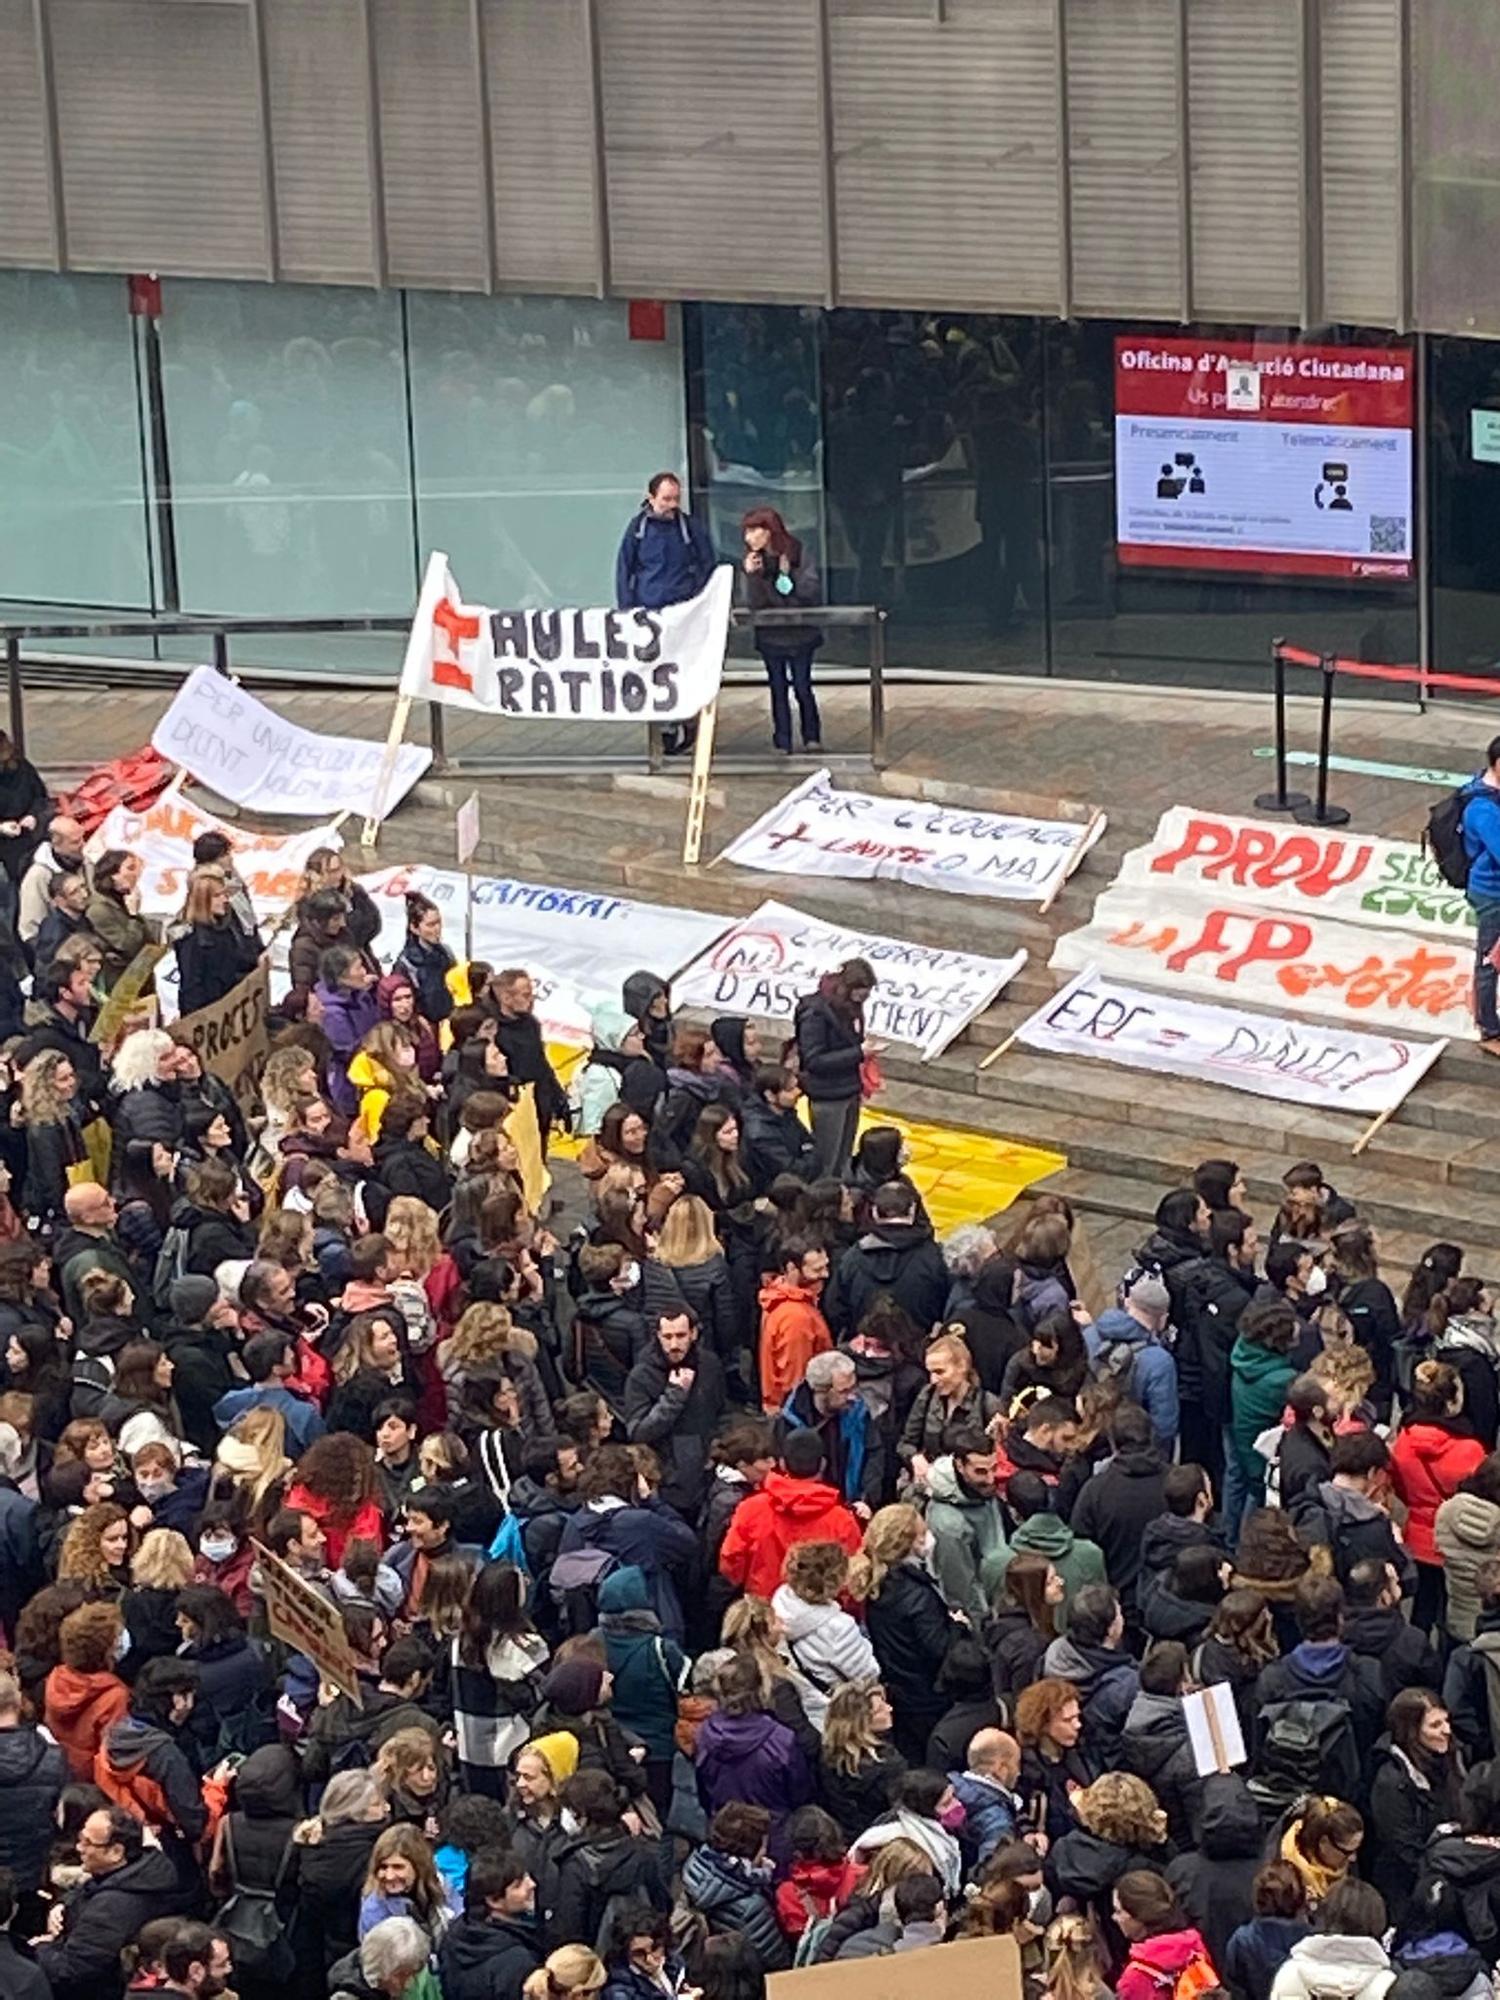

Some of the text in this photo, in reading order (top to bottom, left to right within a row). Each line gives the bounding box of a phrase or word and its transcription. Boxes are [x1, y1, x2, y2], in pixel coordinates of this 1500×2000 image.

[1121, 350, 1192, 372] Oficina
[1298, 358, 1405, 381] Ciutadana
[1130, 424, 1239, 442] Presencialment
[490, 608, 662, 663] AULES
[1150, 819, 1373, 897] PROU
[1166, 910, 1313, 982] FP
